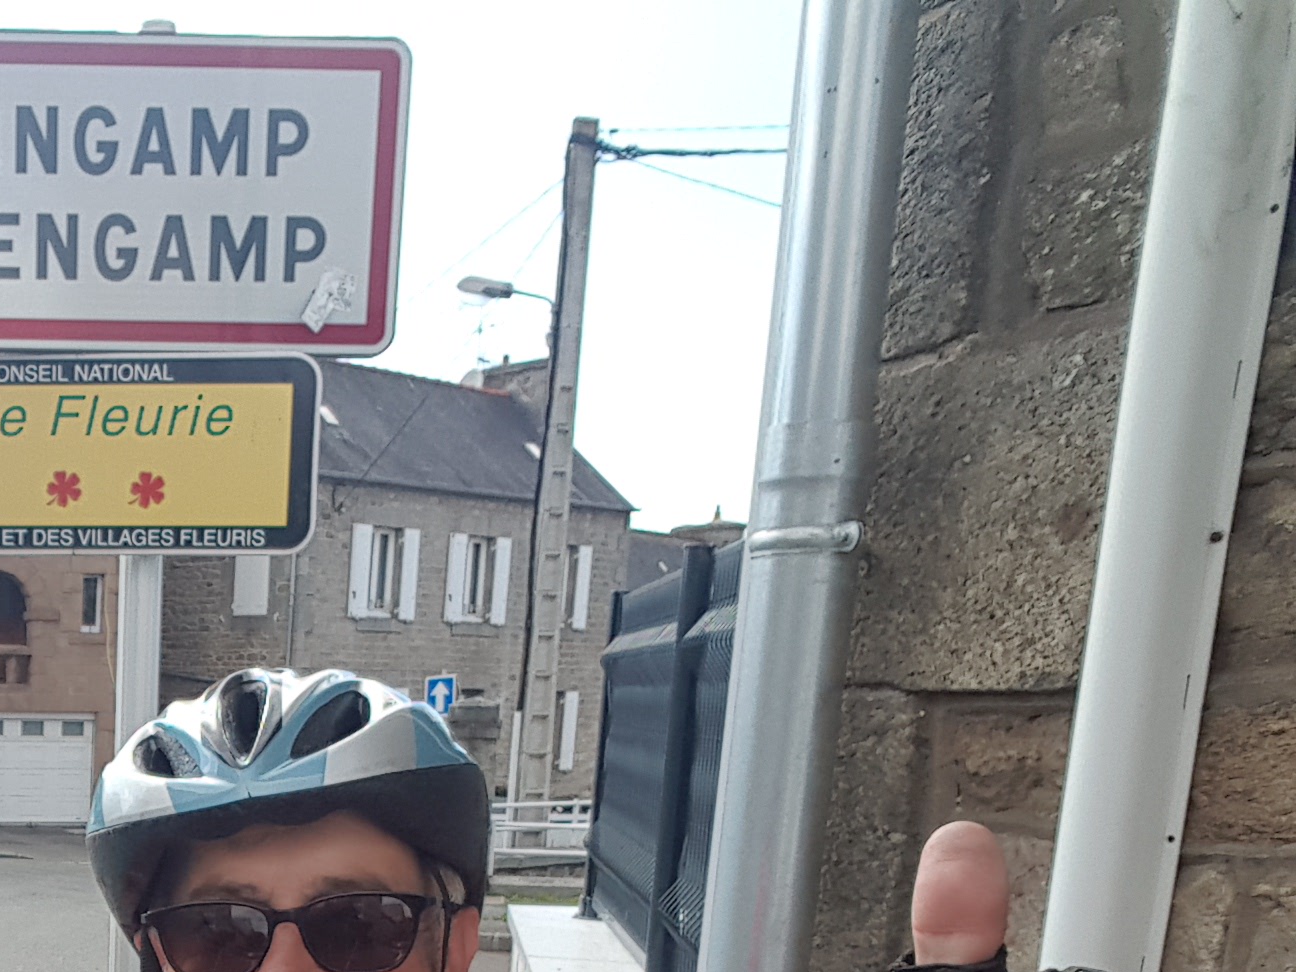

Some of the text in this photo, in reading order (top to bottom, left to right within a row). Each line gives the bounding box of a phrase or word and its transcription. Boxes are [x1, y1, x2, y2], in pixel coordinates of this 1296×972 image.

[74, 363, 174, 382] NATIONAL
[50, 393, 234, 437] Fleurie
[2, 529, 27, 547] ET
[32, 529, 73, 547] DES
[78, 529, 174, 547] VILLAGES
[180, 529, 266, 547] FLEURIS
